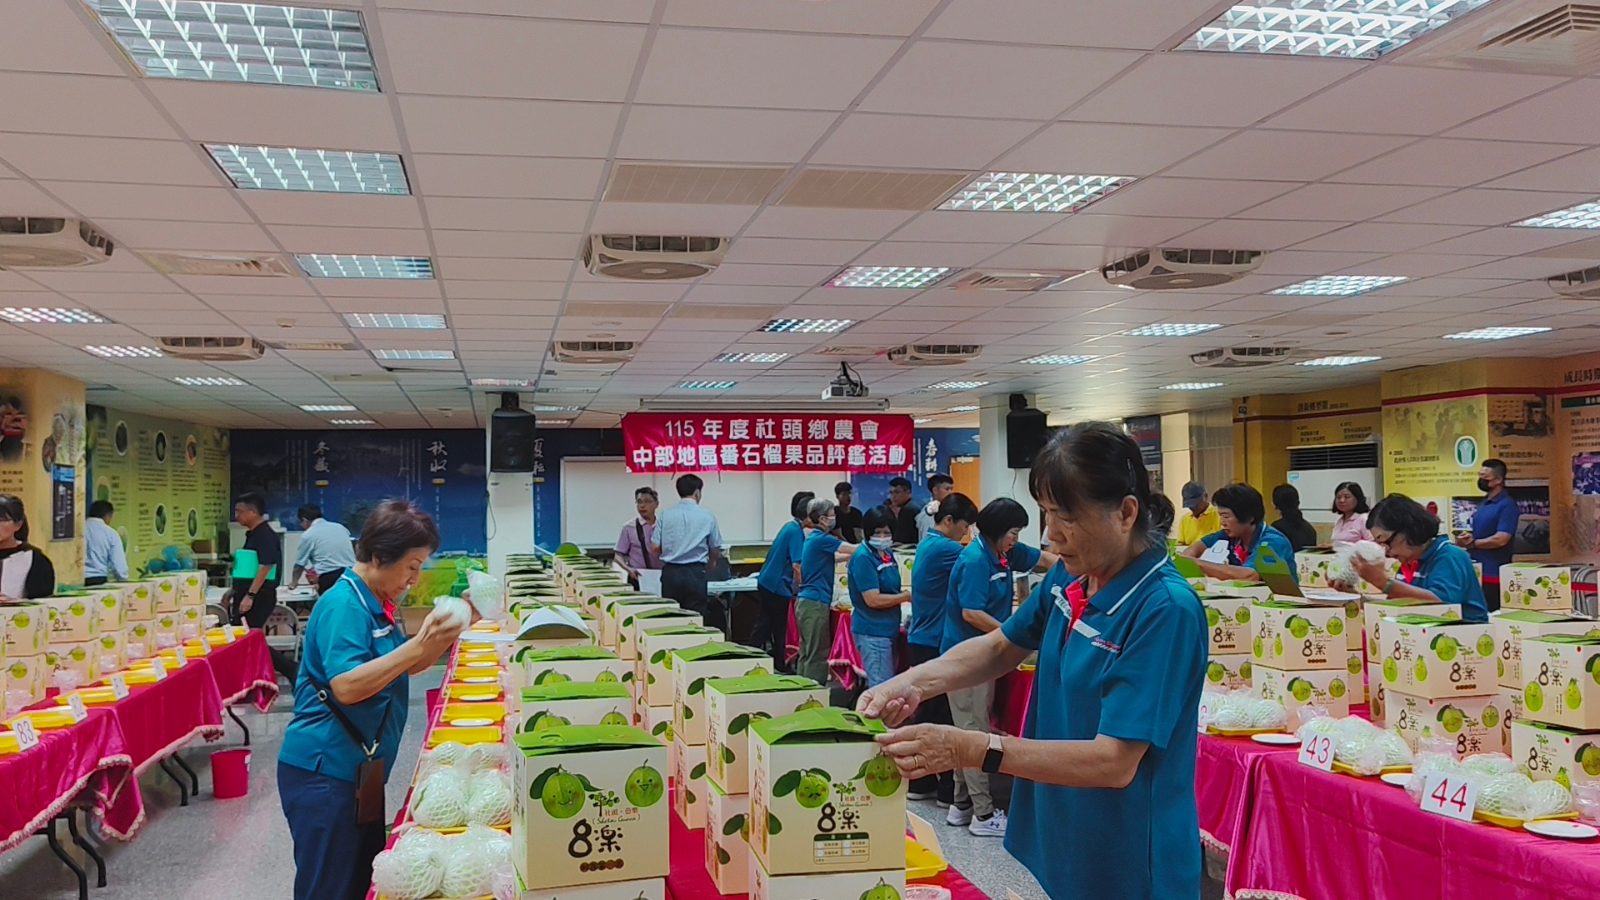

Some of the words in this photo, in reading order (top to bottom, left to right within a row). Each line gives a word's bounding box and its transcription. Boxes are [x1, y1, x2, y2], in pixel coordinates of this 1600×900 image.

[632, 443, 907, 468] 中部地區番石榴果品評鑑活動
[17, 720, 34, 744] 83
[1306, 735, 1331, 765] 43
[1431, 778, 1468, 813] 44
